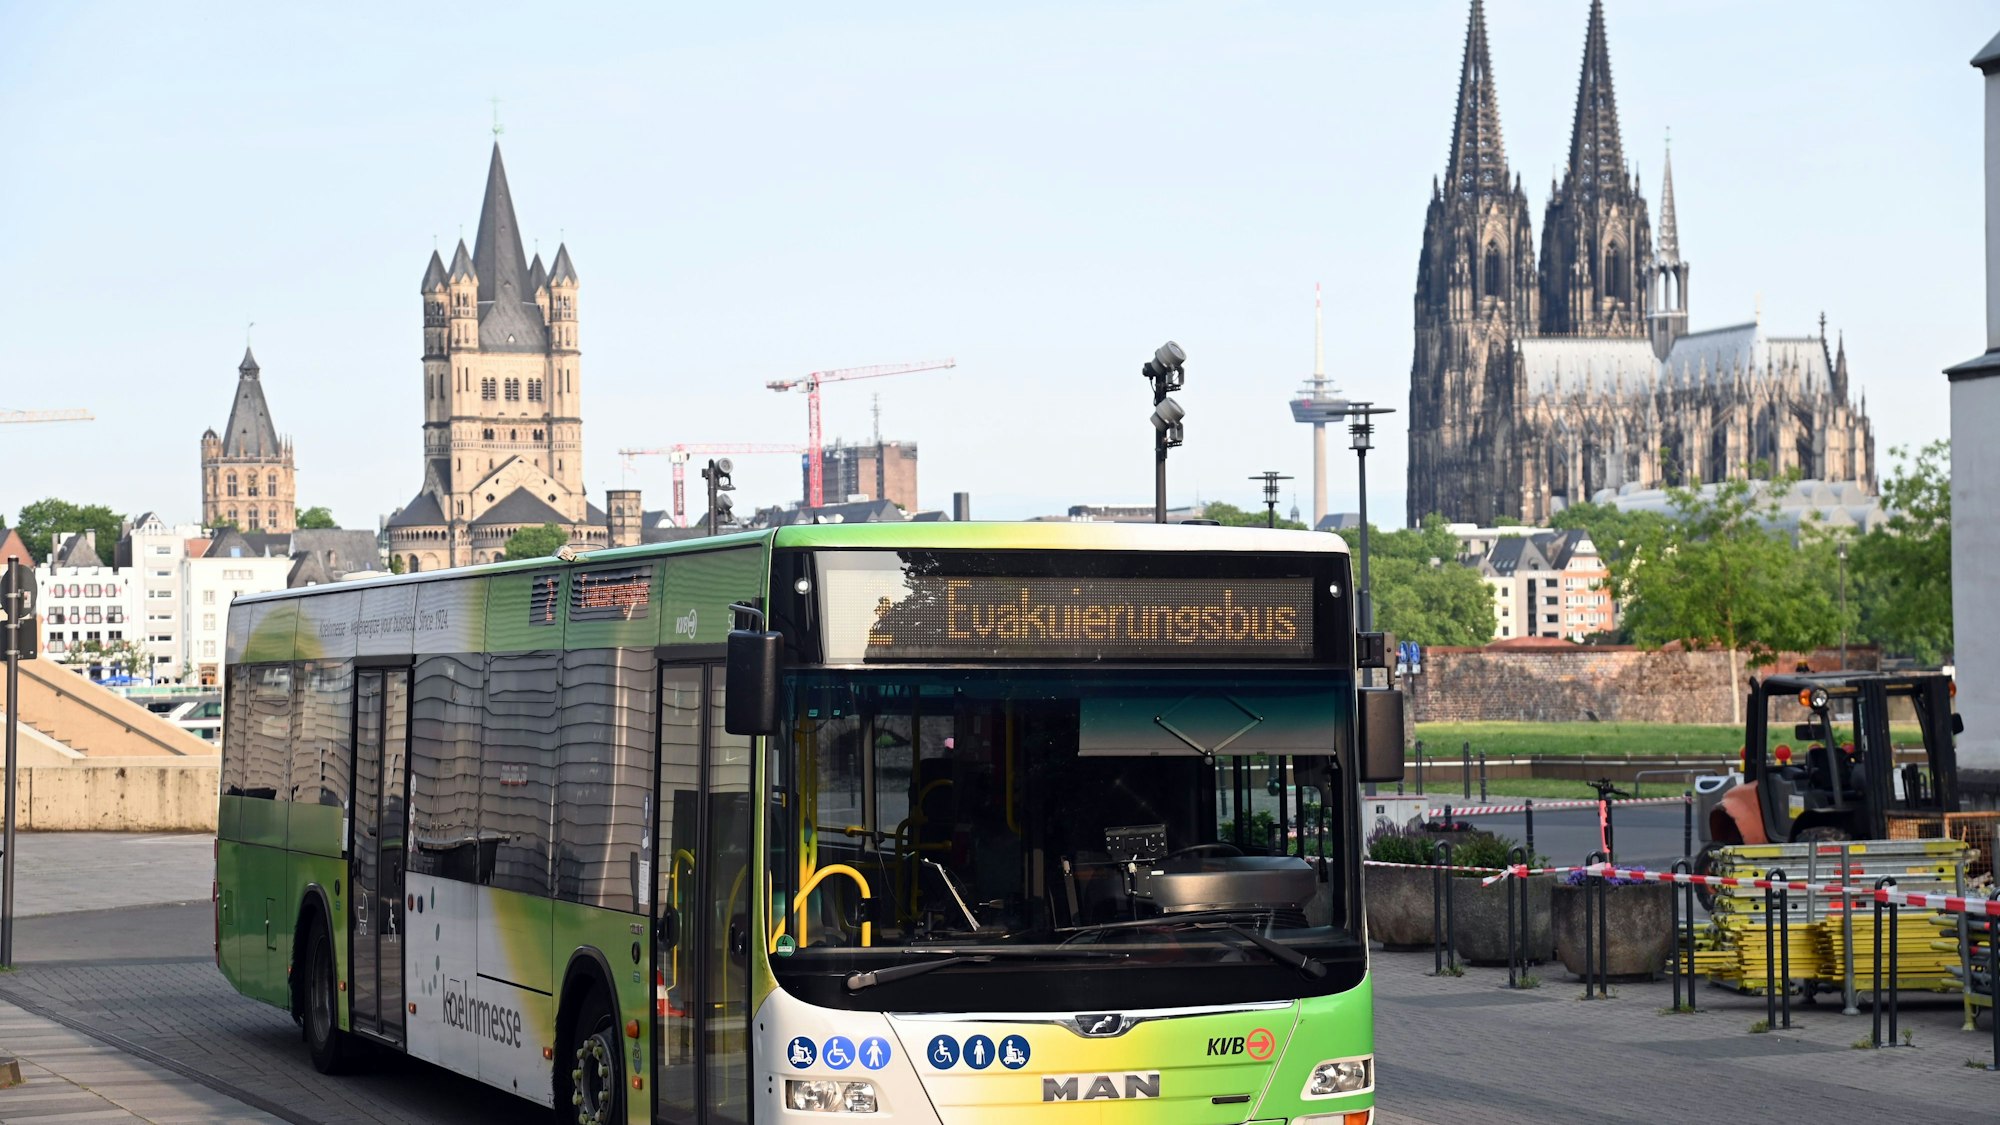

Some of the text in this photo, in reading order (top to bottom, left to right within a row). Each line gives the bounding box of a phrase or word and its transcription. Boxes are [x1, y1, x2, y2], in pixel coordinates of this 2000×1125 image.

[947, 580, 1297, 643] Evakuierungsbus
[676, 616, 689, 635] KVB
[781, 935, 788, 946] 4
[442, 973, 521, 1049] koelnmesse
[1207, 1036, 1245, 1056] KVB
[1043, 1073, 1160, 1102] MAN
